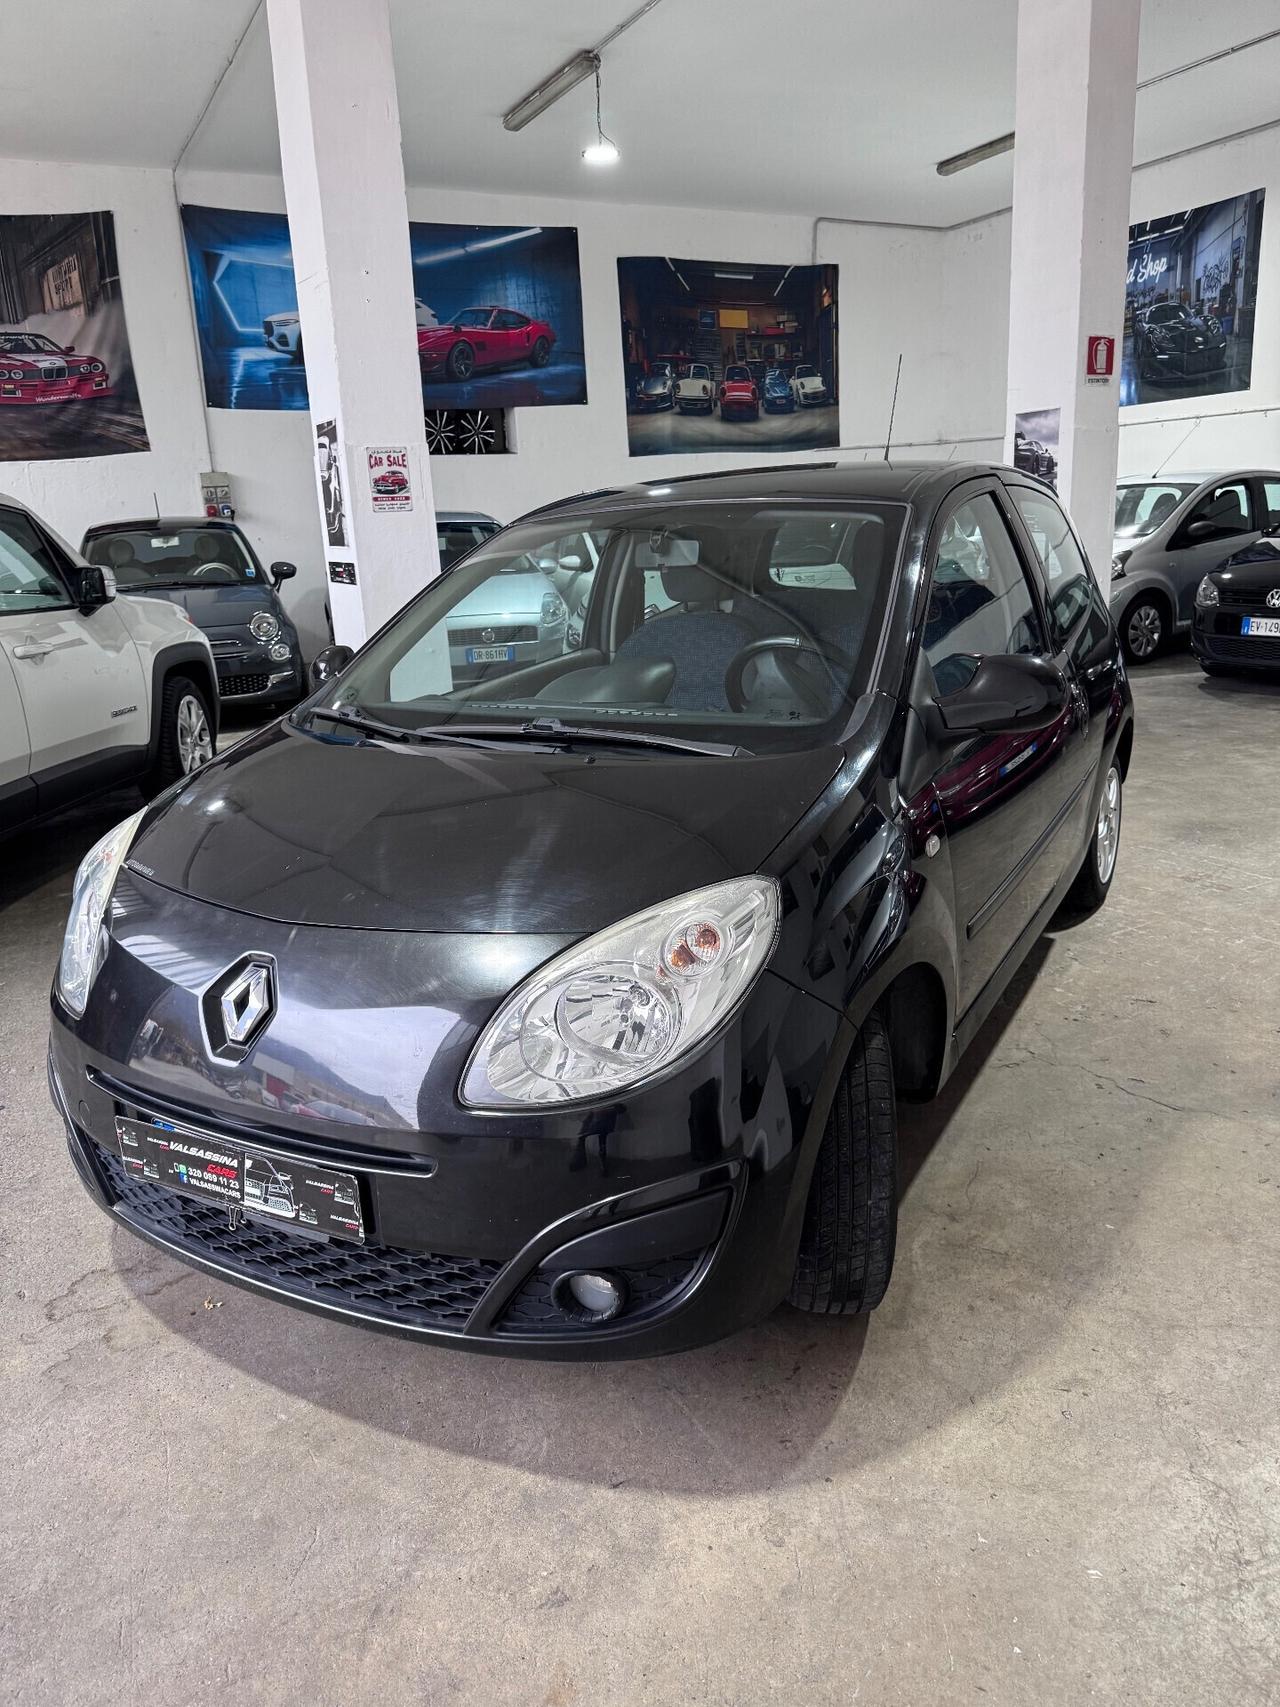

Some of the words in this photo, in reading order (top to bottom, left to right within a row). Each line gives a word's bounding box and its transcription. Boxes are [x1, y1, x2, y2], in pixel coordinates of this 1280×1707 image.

[1137, 253, 1168, 283] Shop
[369, 454, 383, 469] CAR
[387, 454, 407, 468] SALE
[169, 1141, 238, 1168] VALSASSINA
[187, 1167, 202, 1178] 320
[229, 1180, 240, 1189] 23
[206, 1164, 238, 1179] CARS
